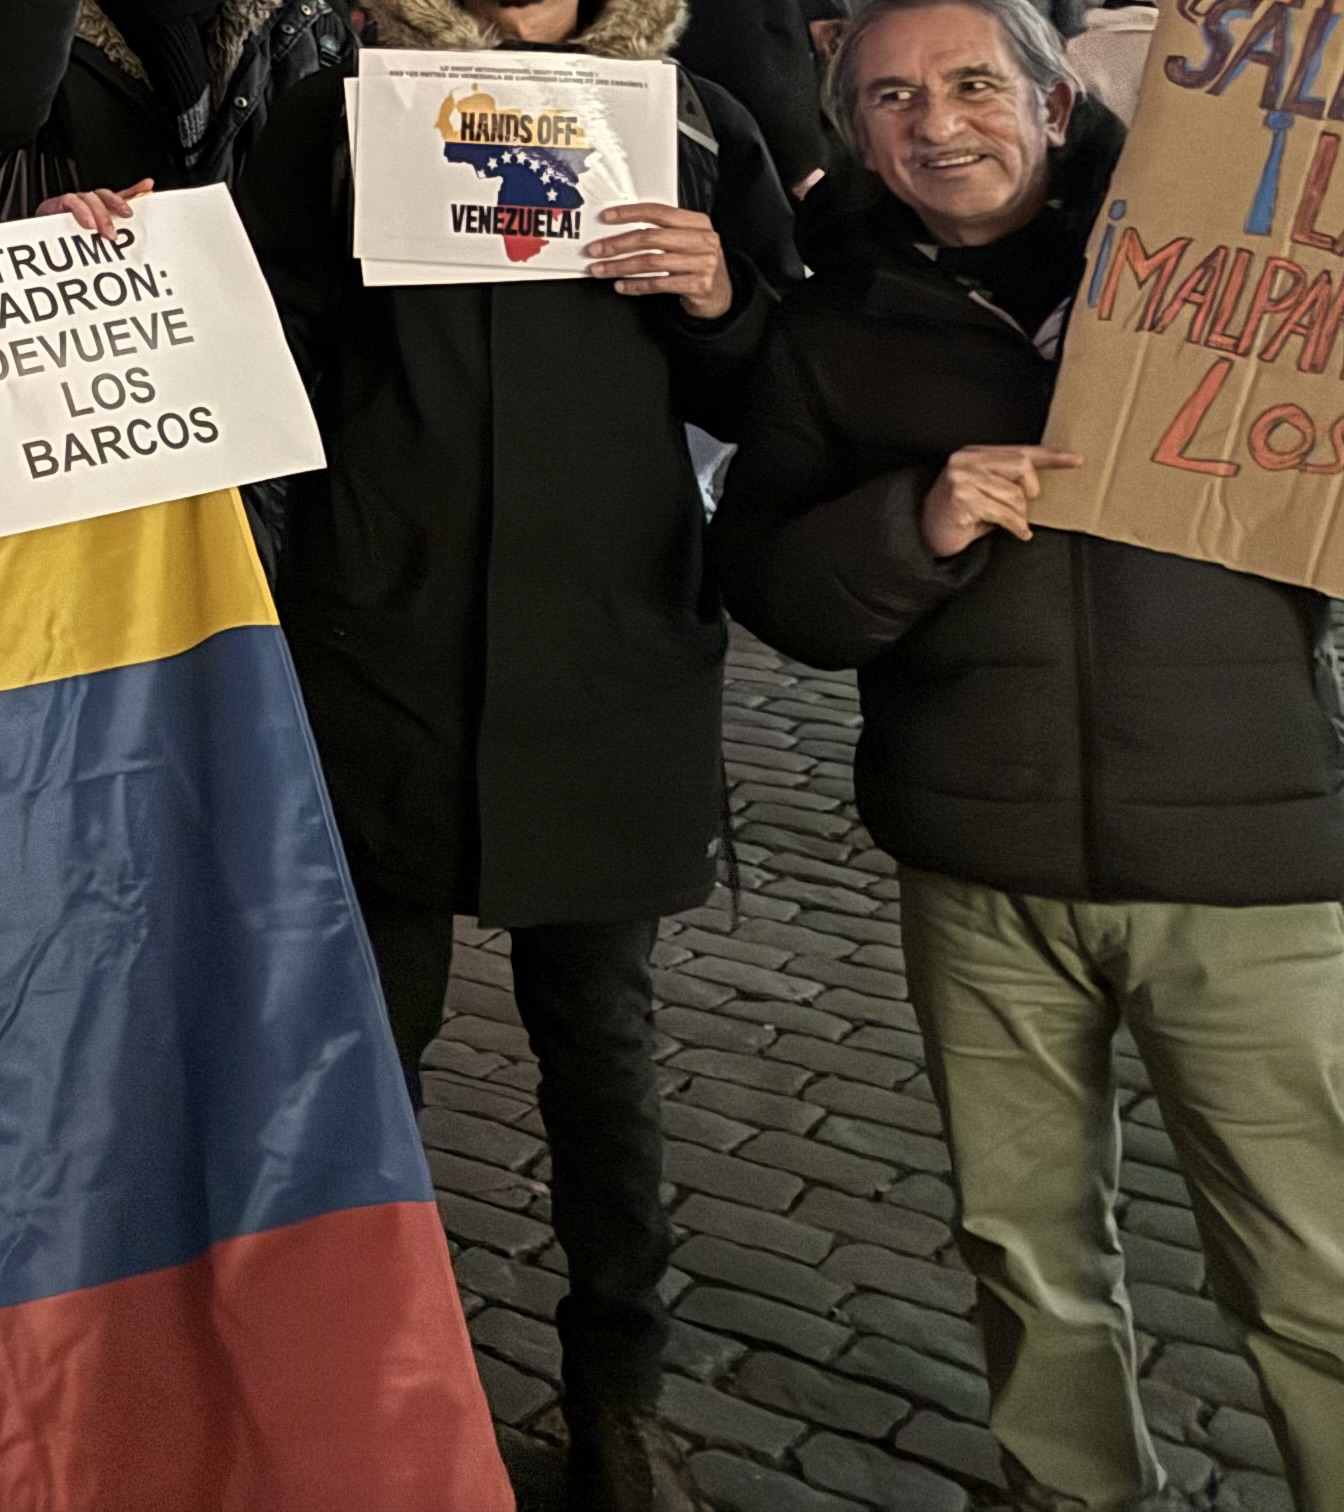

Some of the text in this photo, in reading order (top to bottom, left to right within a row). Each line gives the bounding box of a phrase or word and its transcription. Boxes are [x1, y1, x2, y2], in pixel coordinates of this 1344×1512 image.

[460, 111, 578, 145] HANDS OFF
[451, 204, 581, 239] VENEZUELA!
[60, 366, 156, 418] LOS
[22, 406, 219, 479] BARCOS
